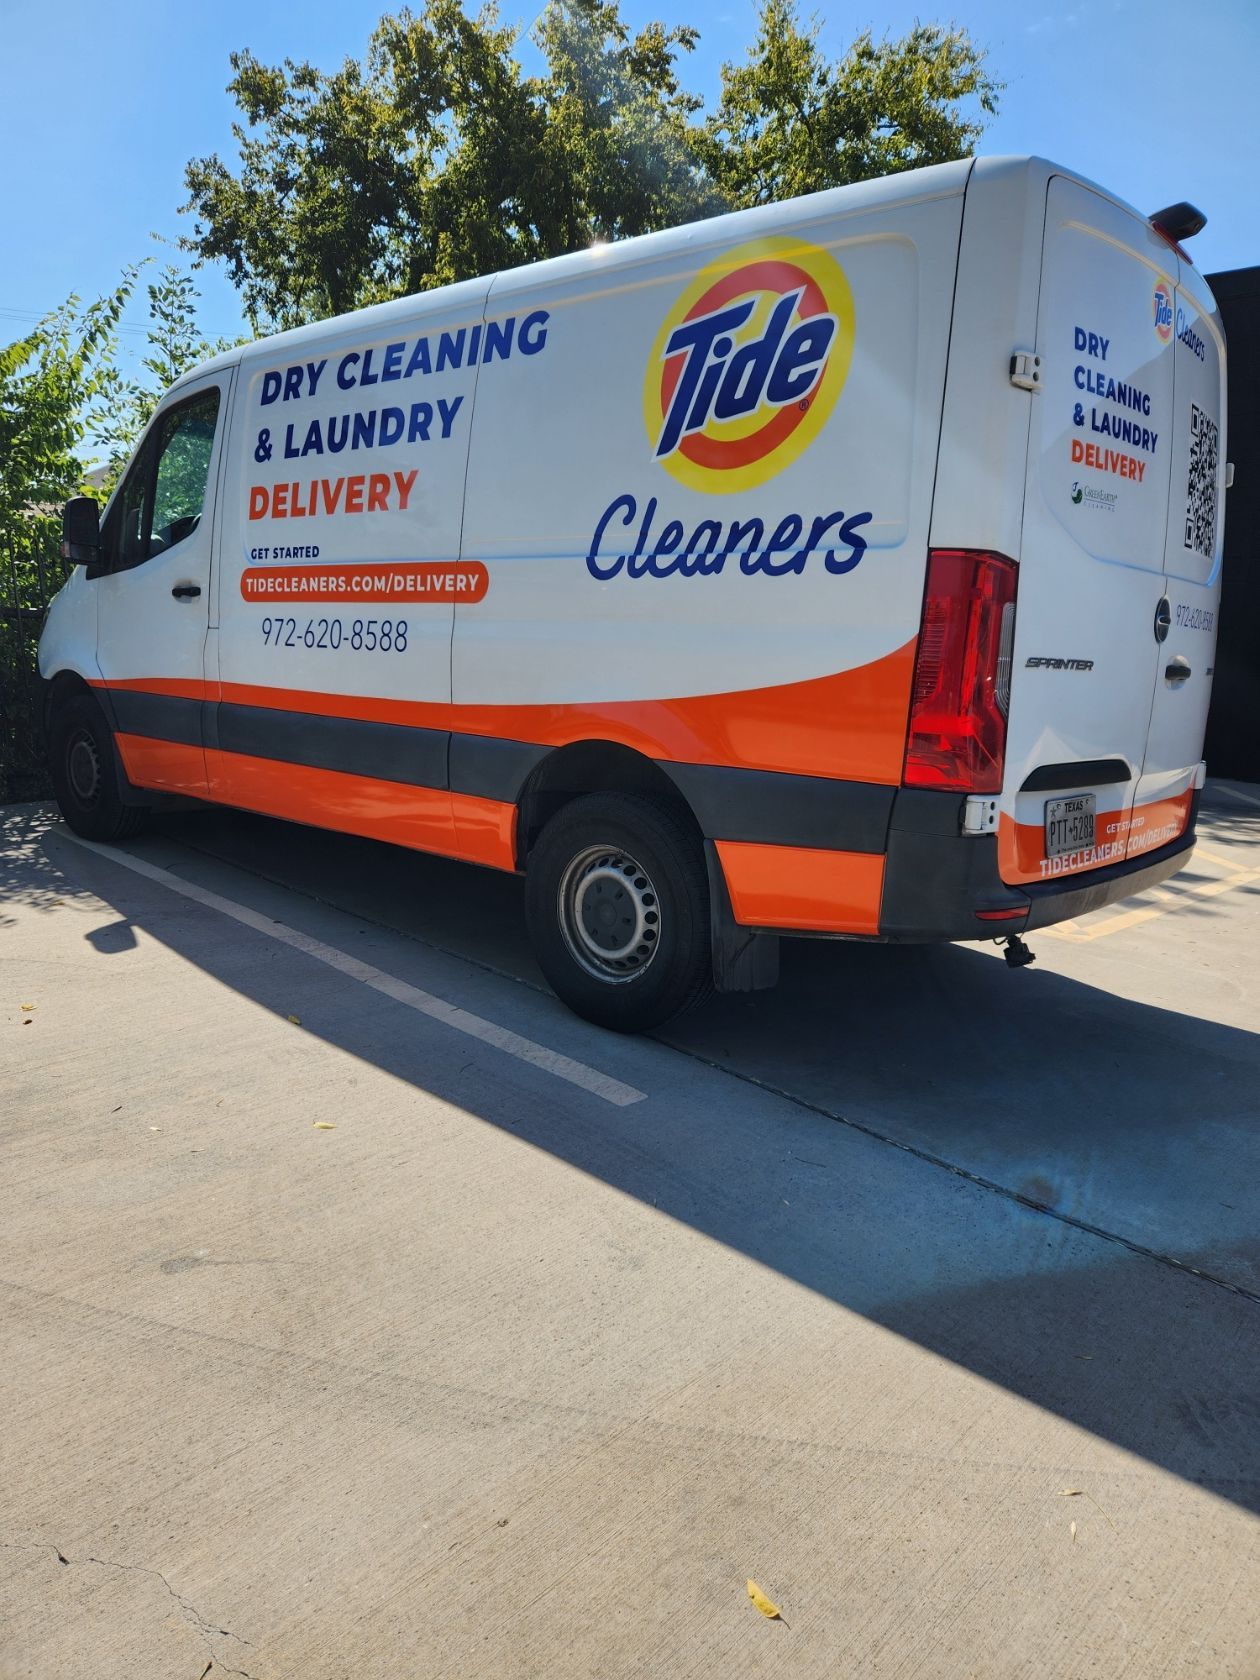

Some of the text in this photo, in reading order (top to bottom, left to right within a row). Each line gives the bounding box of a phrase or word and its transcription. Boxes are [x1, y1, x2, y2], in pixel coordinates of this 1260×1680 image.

[1154, 292, 1173, 328] Tide
[1074, 326, 1110, 361] DRY
[1176, 307, 1205, 362] Cleaners
[260, 310, 550, 406] DRY CLEANING
[655, 288, 837, 459] Tide
[1073, 365, 1151, 417] CLEANING
[254, 396, 464, 463] & LAUNDRY
[1073, 402, 1158, 454] & LAUNDRY
[1071, 438, 1146, 483] DELIVERY
[248, 470, 419, 521] DELIVERY
[250, 545, 320, 560] GET STARTED
[585, 494, 873, 581] Cleaners
[246, 573, 479, 594] TIDECLEANERS.COM/DELIVERY
[262, 617, 408, 653] 972-620-8588
[1025, 657, 1094, 671] SPRINTER
[1065, 800, 1084, 813] TEXAS
[1106, 817, 1144, 834] GET STARTED
